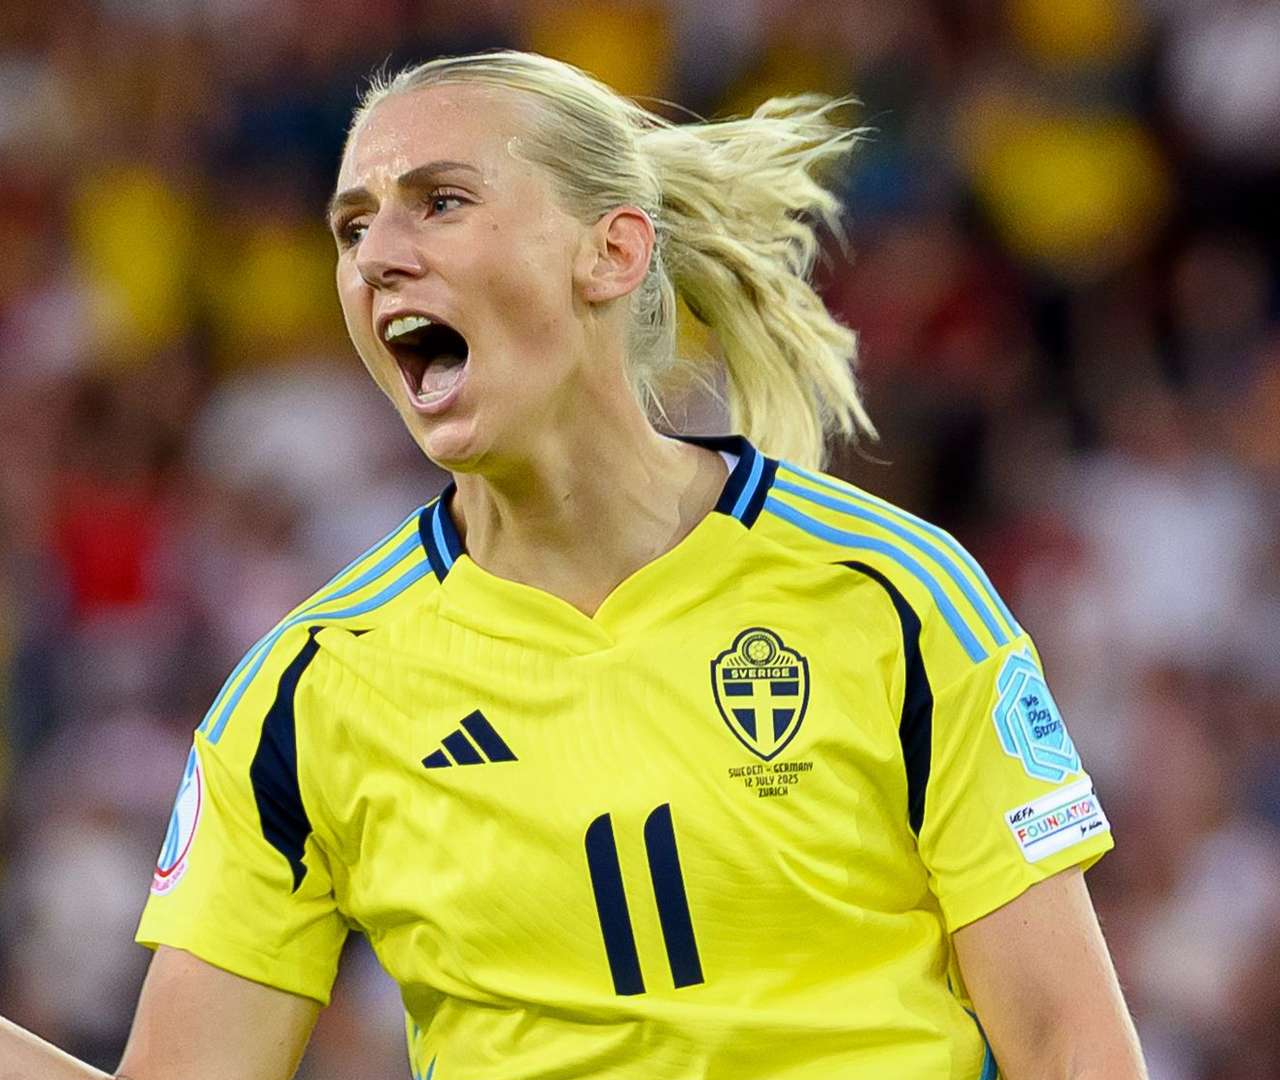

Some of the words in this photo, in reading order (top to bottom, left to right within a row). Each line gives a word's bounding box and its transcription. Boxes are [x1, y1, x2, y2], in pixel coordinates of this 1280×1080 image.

[731, 667, 790, 679] SVERIGE
[728, 764, 764, 778] SWEDEN
[773, 761, 814, 773] GERMANY
[744, 777, 753, 787] 12
[755, 775, 775, 787] JULY
[777, 773, 799, 785] 2025
[758, 786, 789, 798] ZURICH
[1009, 807, 1035, 824] UEFA
[584, 802, 705, 996] 11
